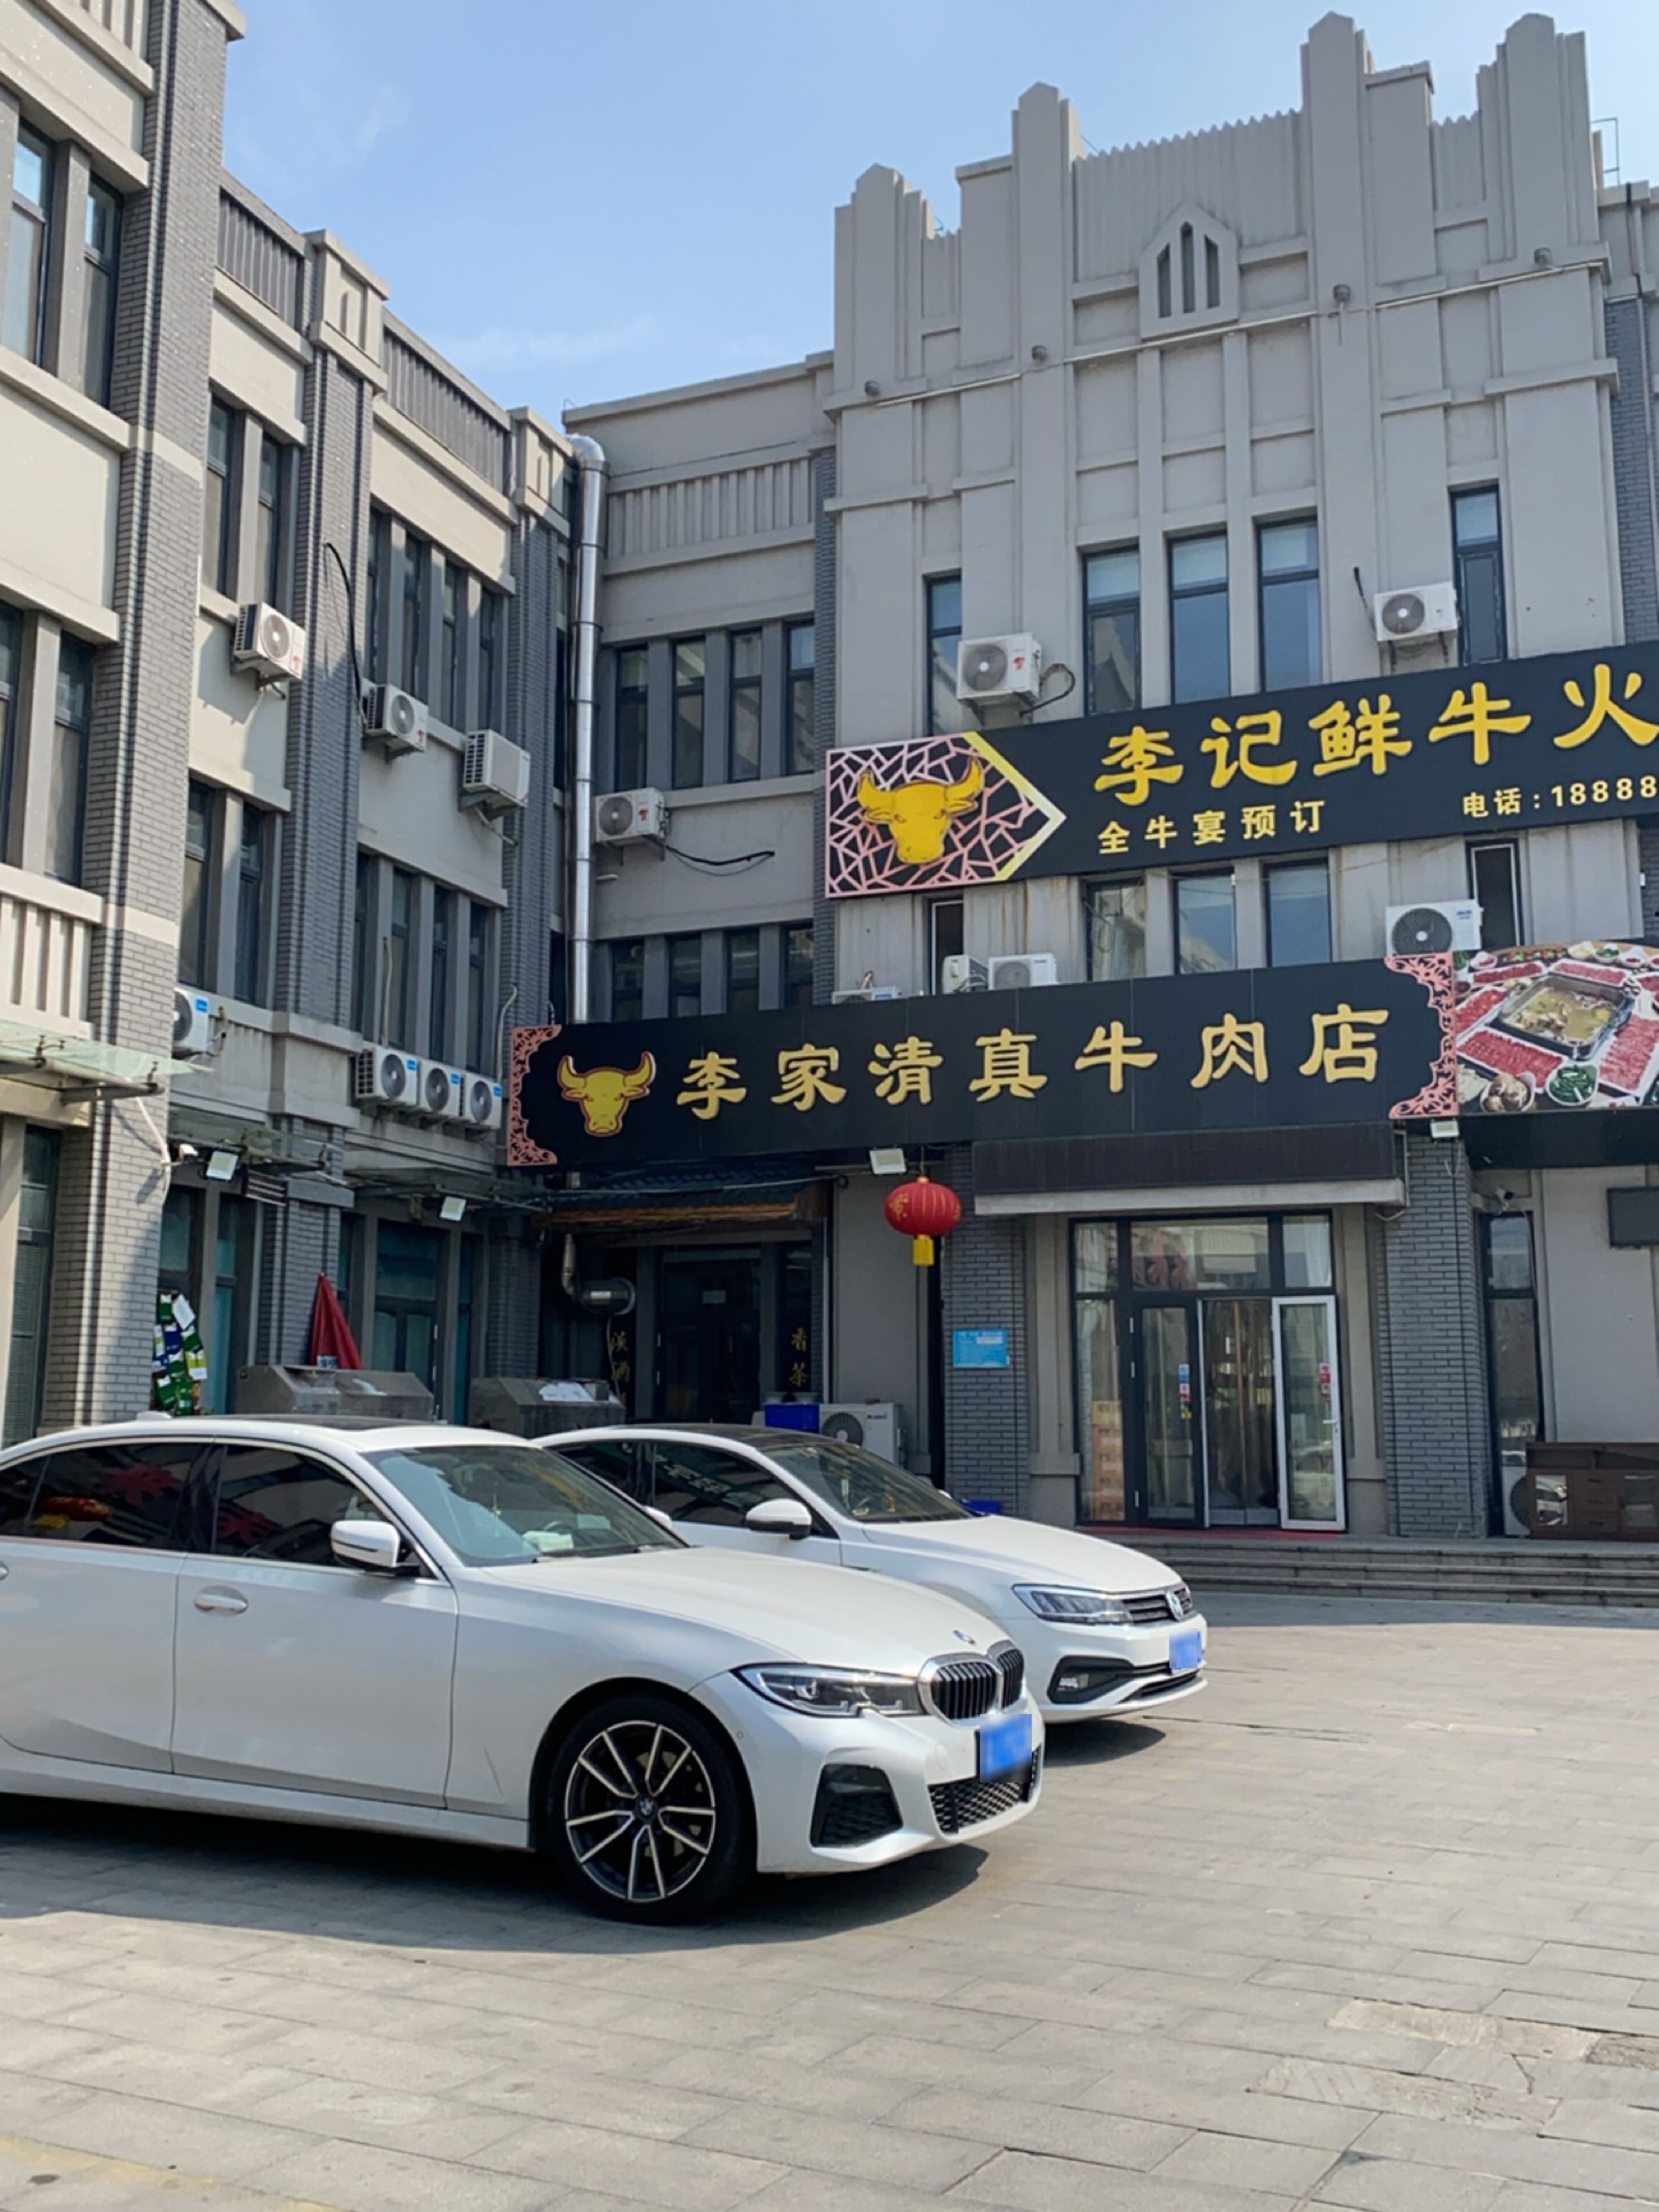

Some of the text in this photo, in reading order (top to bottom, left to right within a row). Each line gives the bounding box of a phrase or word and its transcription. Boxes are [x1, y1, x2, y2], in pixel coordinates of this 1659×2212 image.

[1094, 663, 1659, 806] 李记鲜牛火
[1097, 799, 1326, 854] 全牛宴预订
[677, 1003, 1390, 1119] 李家清真牛肉店
